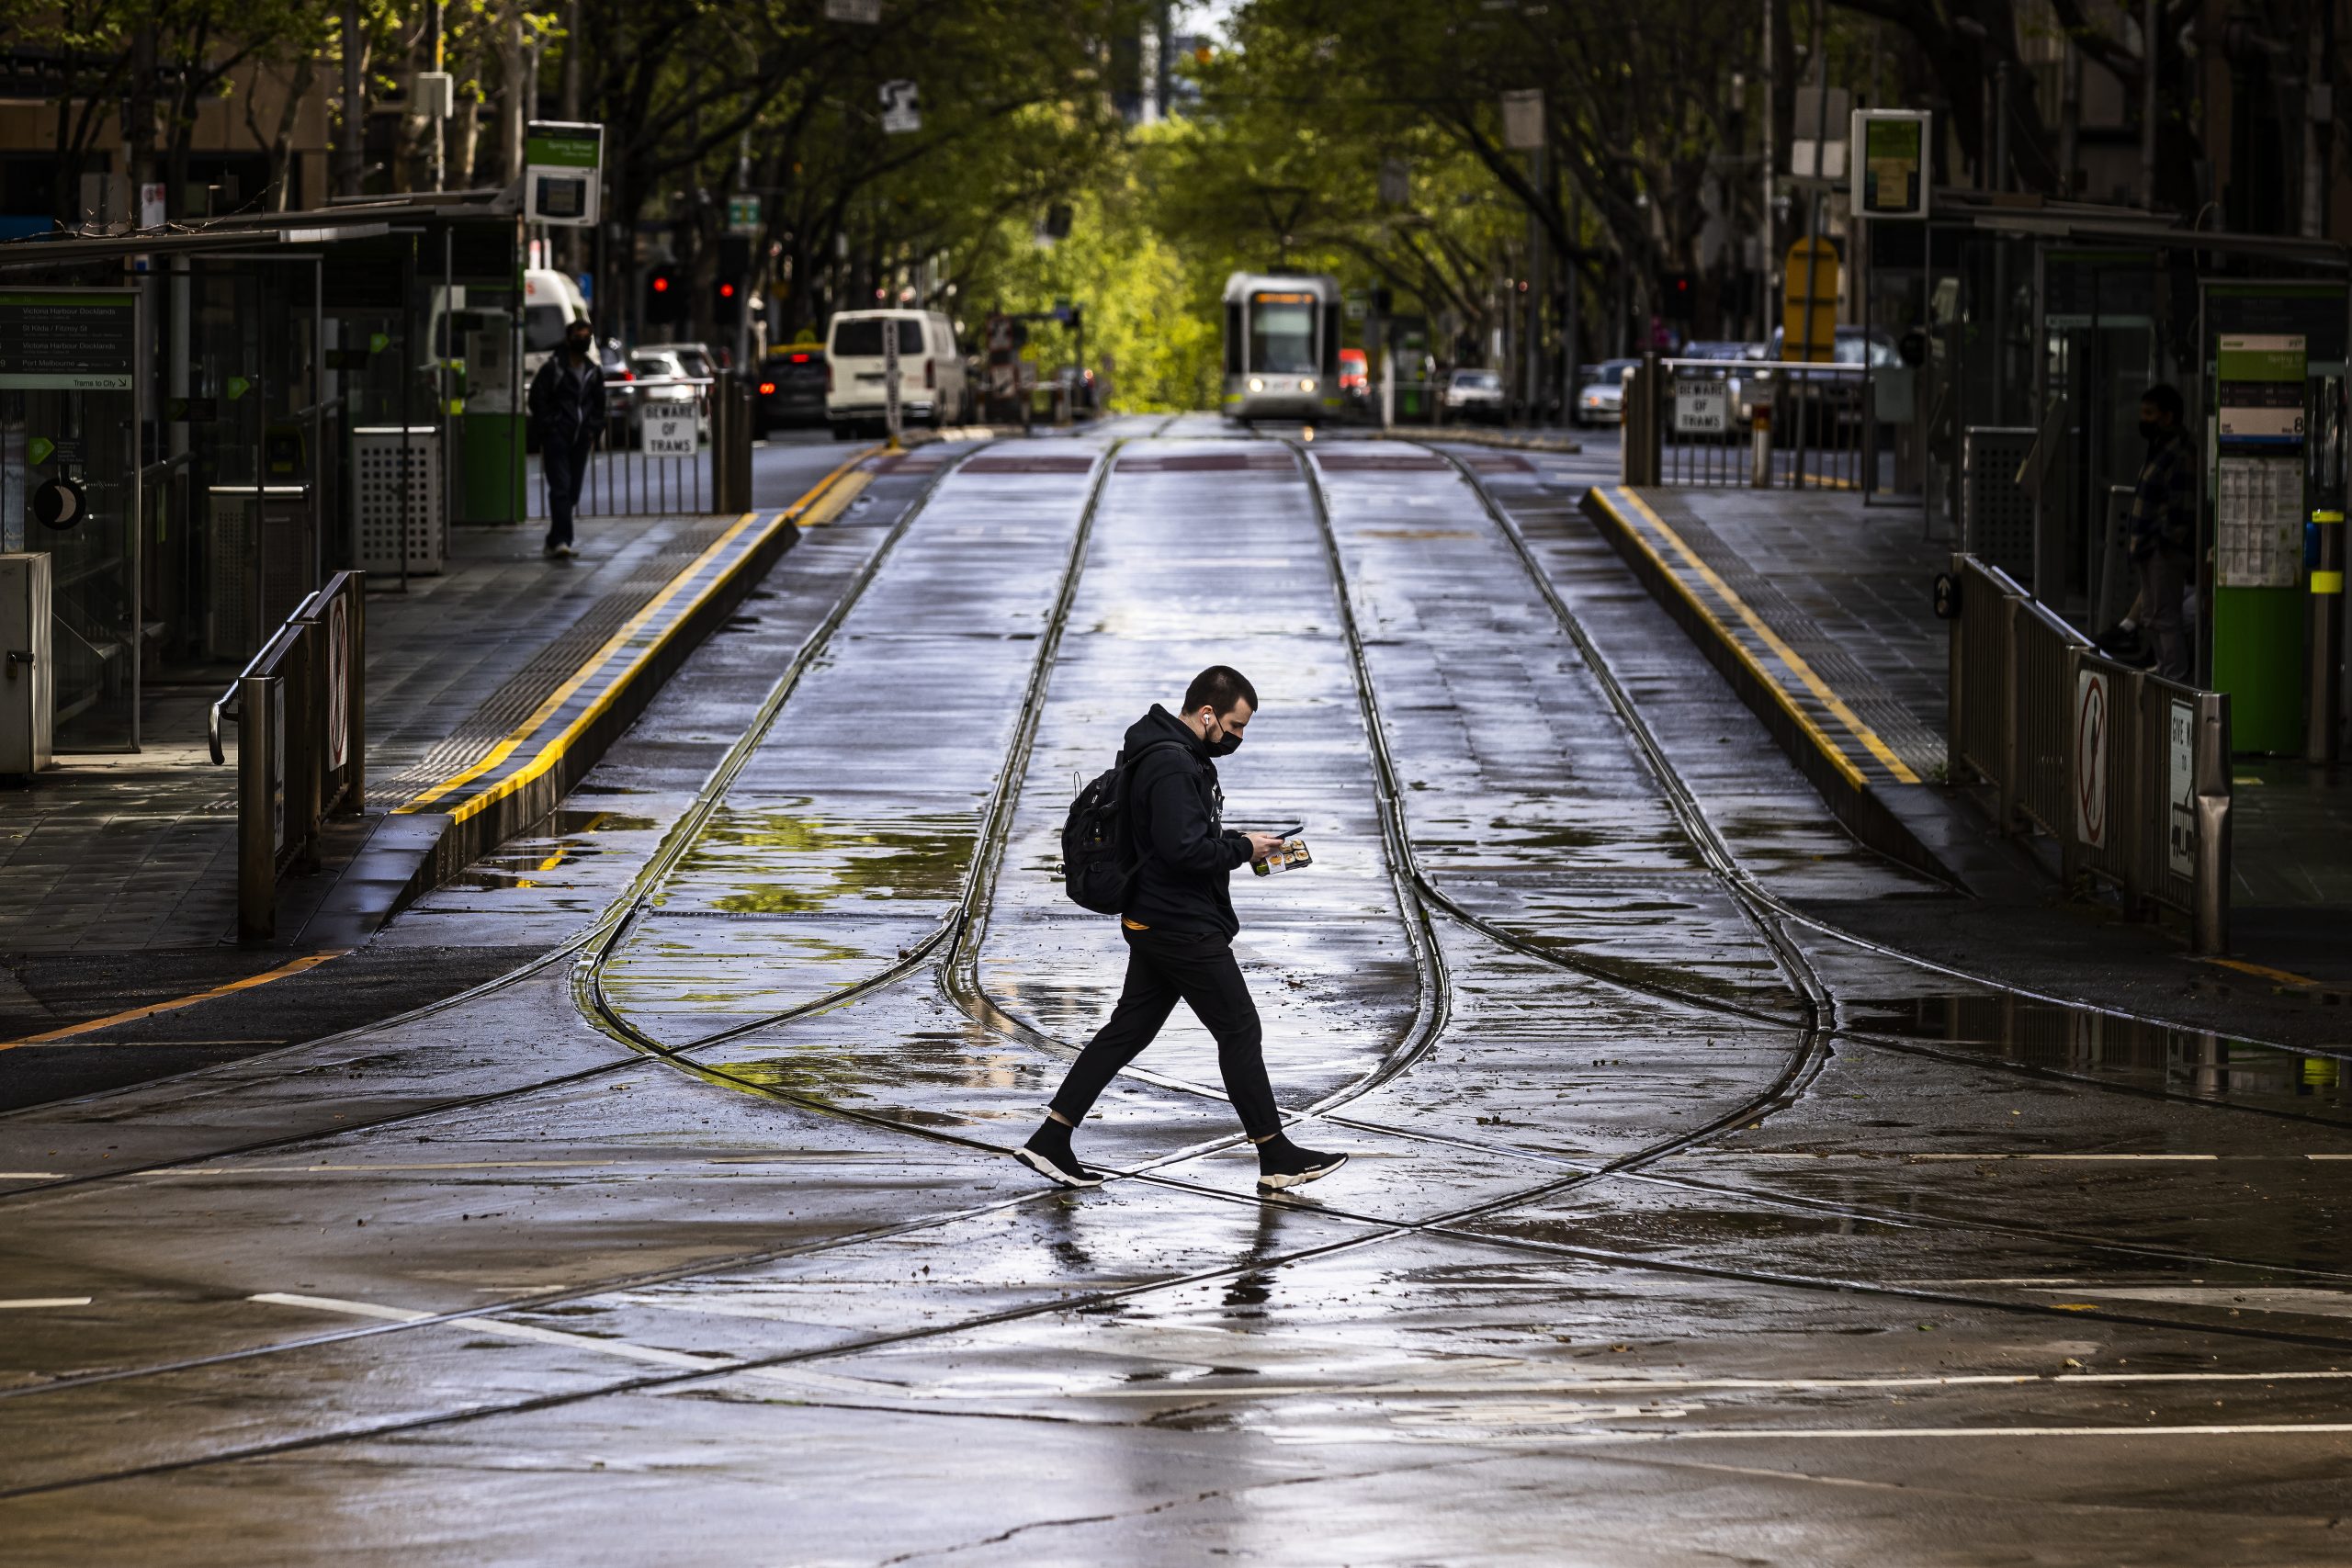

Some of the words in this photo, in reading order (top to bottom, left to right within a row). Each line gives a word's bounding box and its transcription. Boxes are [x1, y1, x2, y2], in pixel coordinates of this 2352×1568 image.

[55, 324, 79, 333] Fitzroy
[103, 379, 116, 388] City
[1679, 384, 1723, 395] BEWARE
[646, 405, 692, 419] BEWARE
[1693, 400, 1708, 412] OF
[1682, 414, 1720, 426] TRAMS
[2294, 416, 2304, 434] 8
[662, 422, 677, 435] OF
[650, 439, 691, 453] TRAMS
[2173, 716, 2184, 745] GIVE
